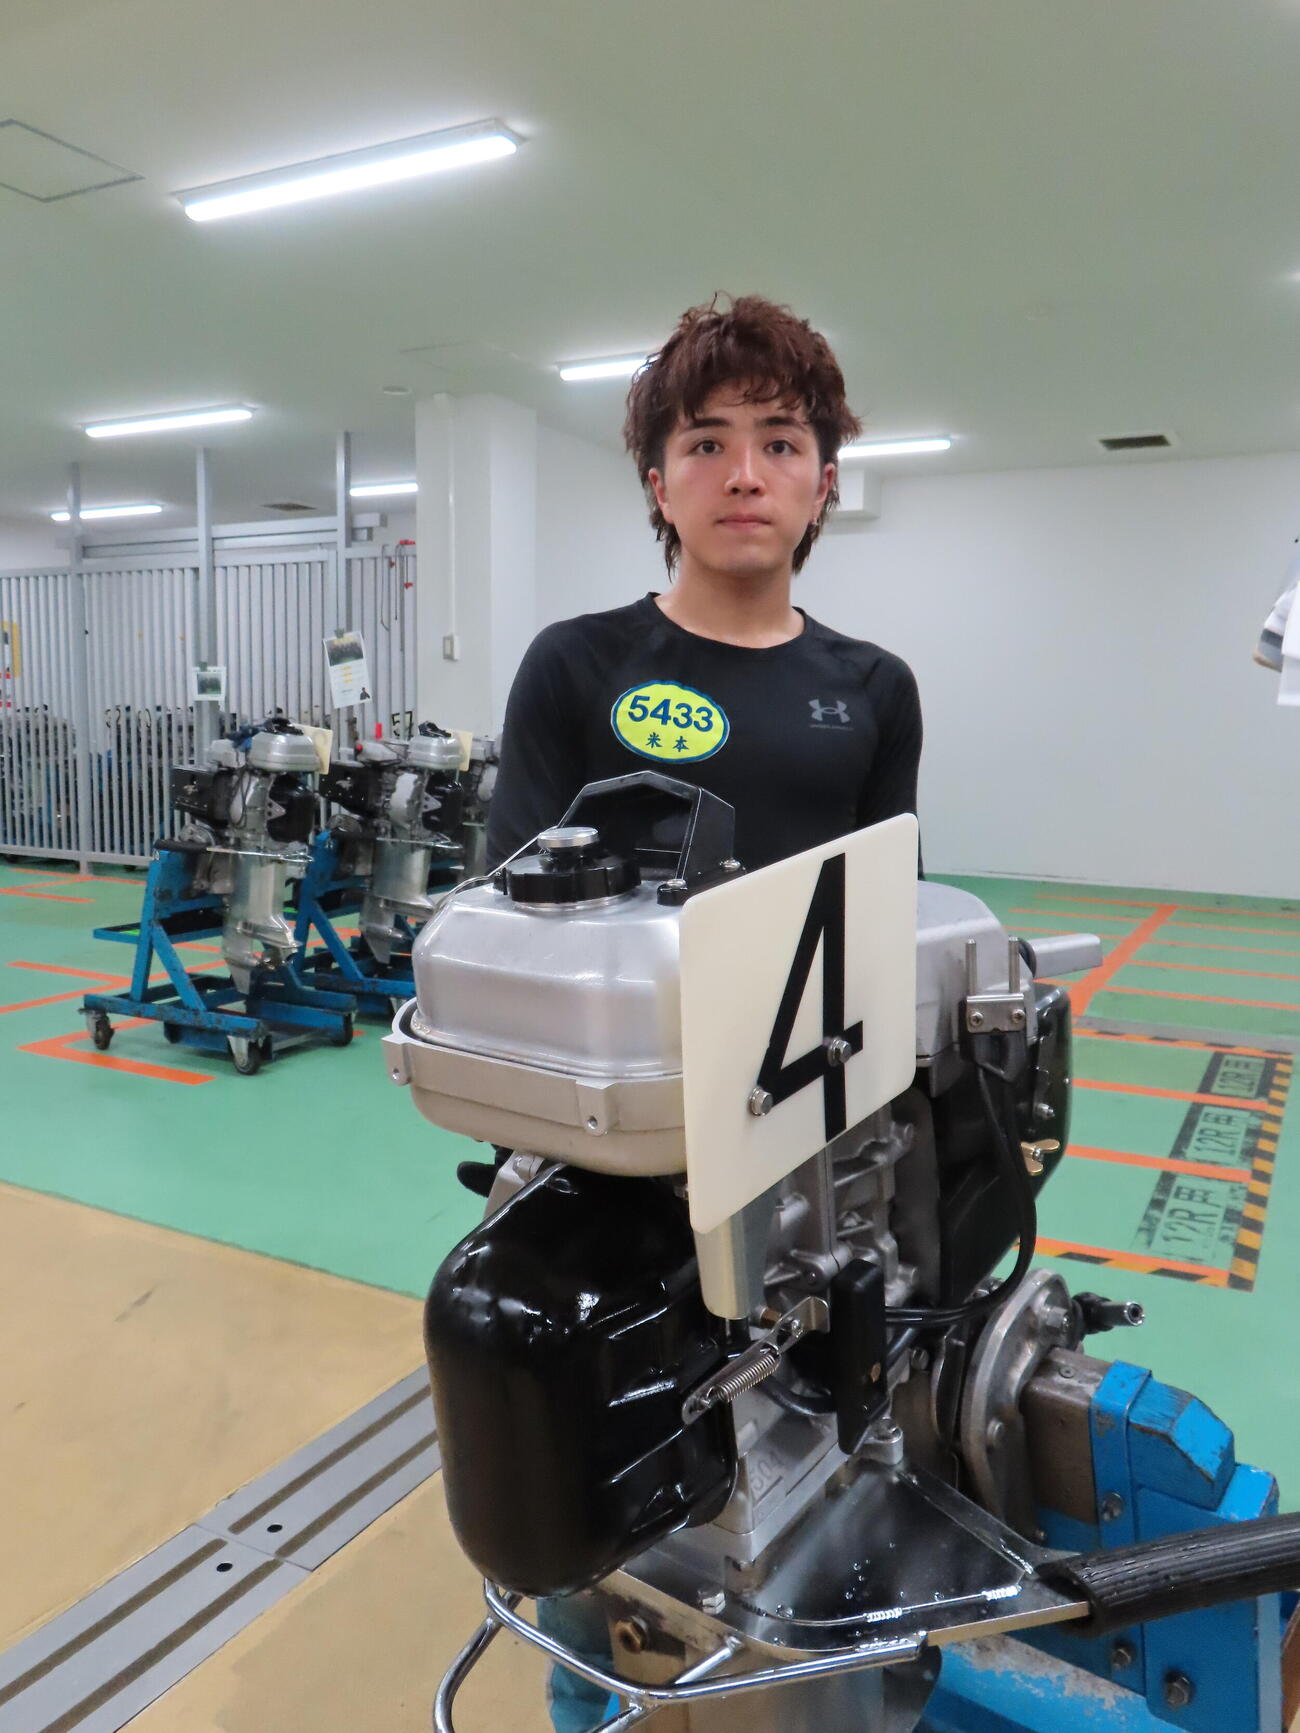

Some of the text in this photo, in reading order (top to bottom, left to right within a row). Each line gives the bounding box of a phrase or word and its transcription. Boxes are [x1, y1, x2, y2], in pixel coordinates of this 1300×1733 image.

[628, 695, 713, 732] 5433
[646, 732, 689, 752] 米本
[757, 853, 863, 1143] 4
